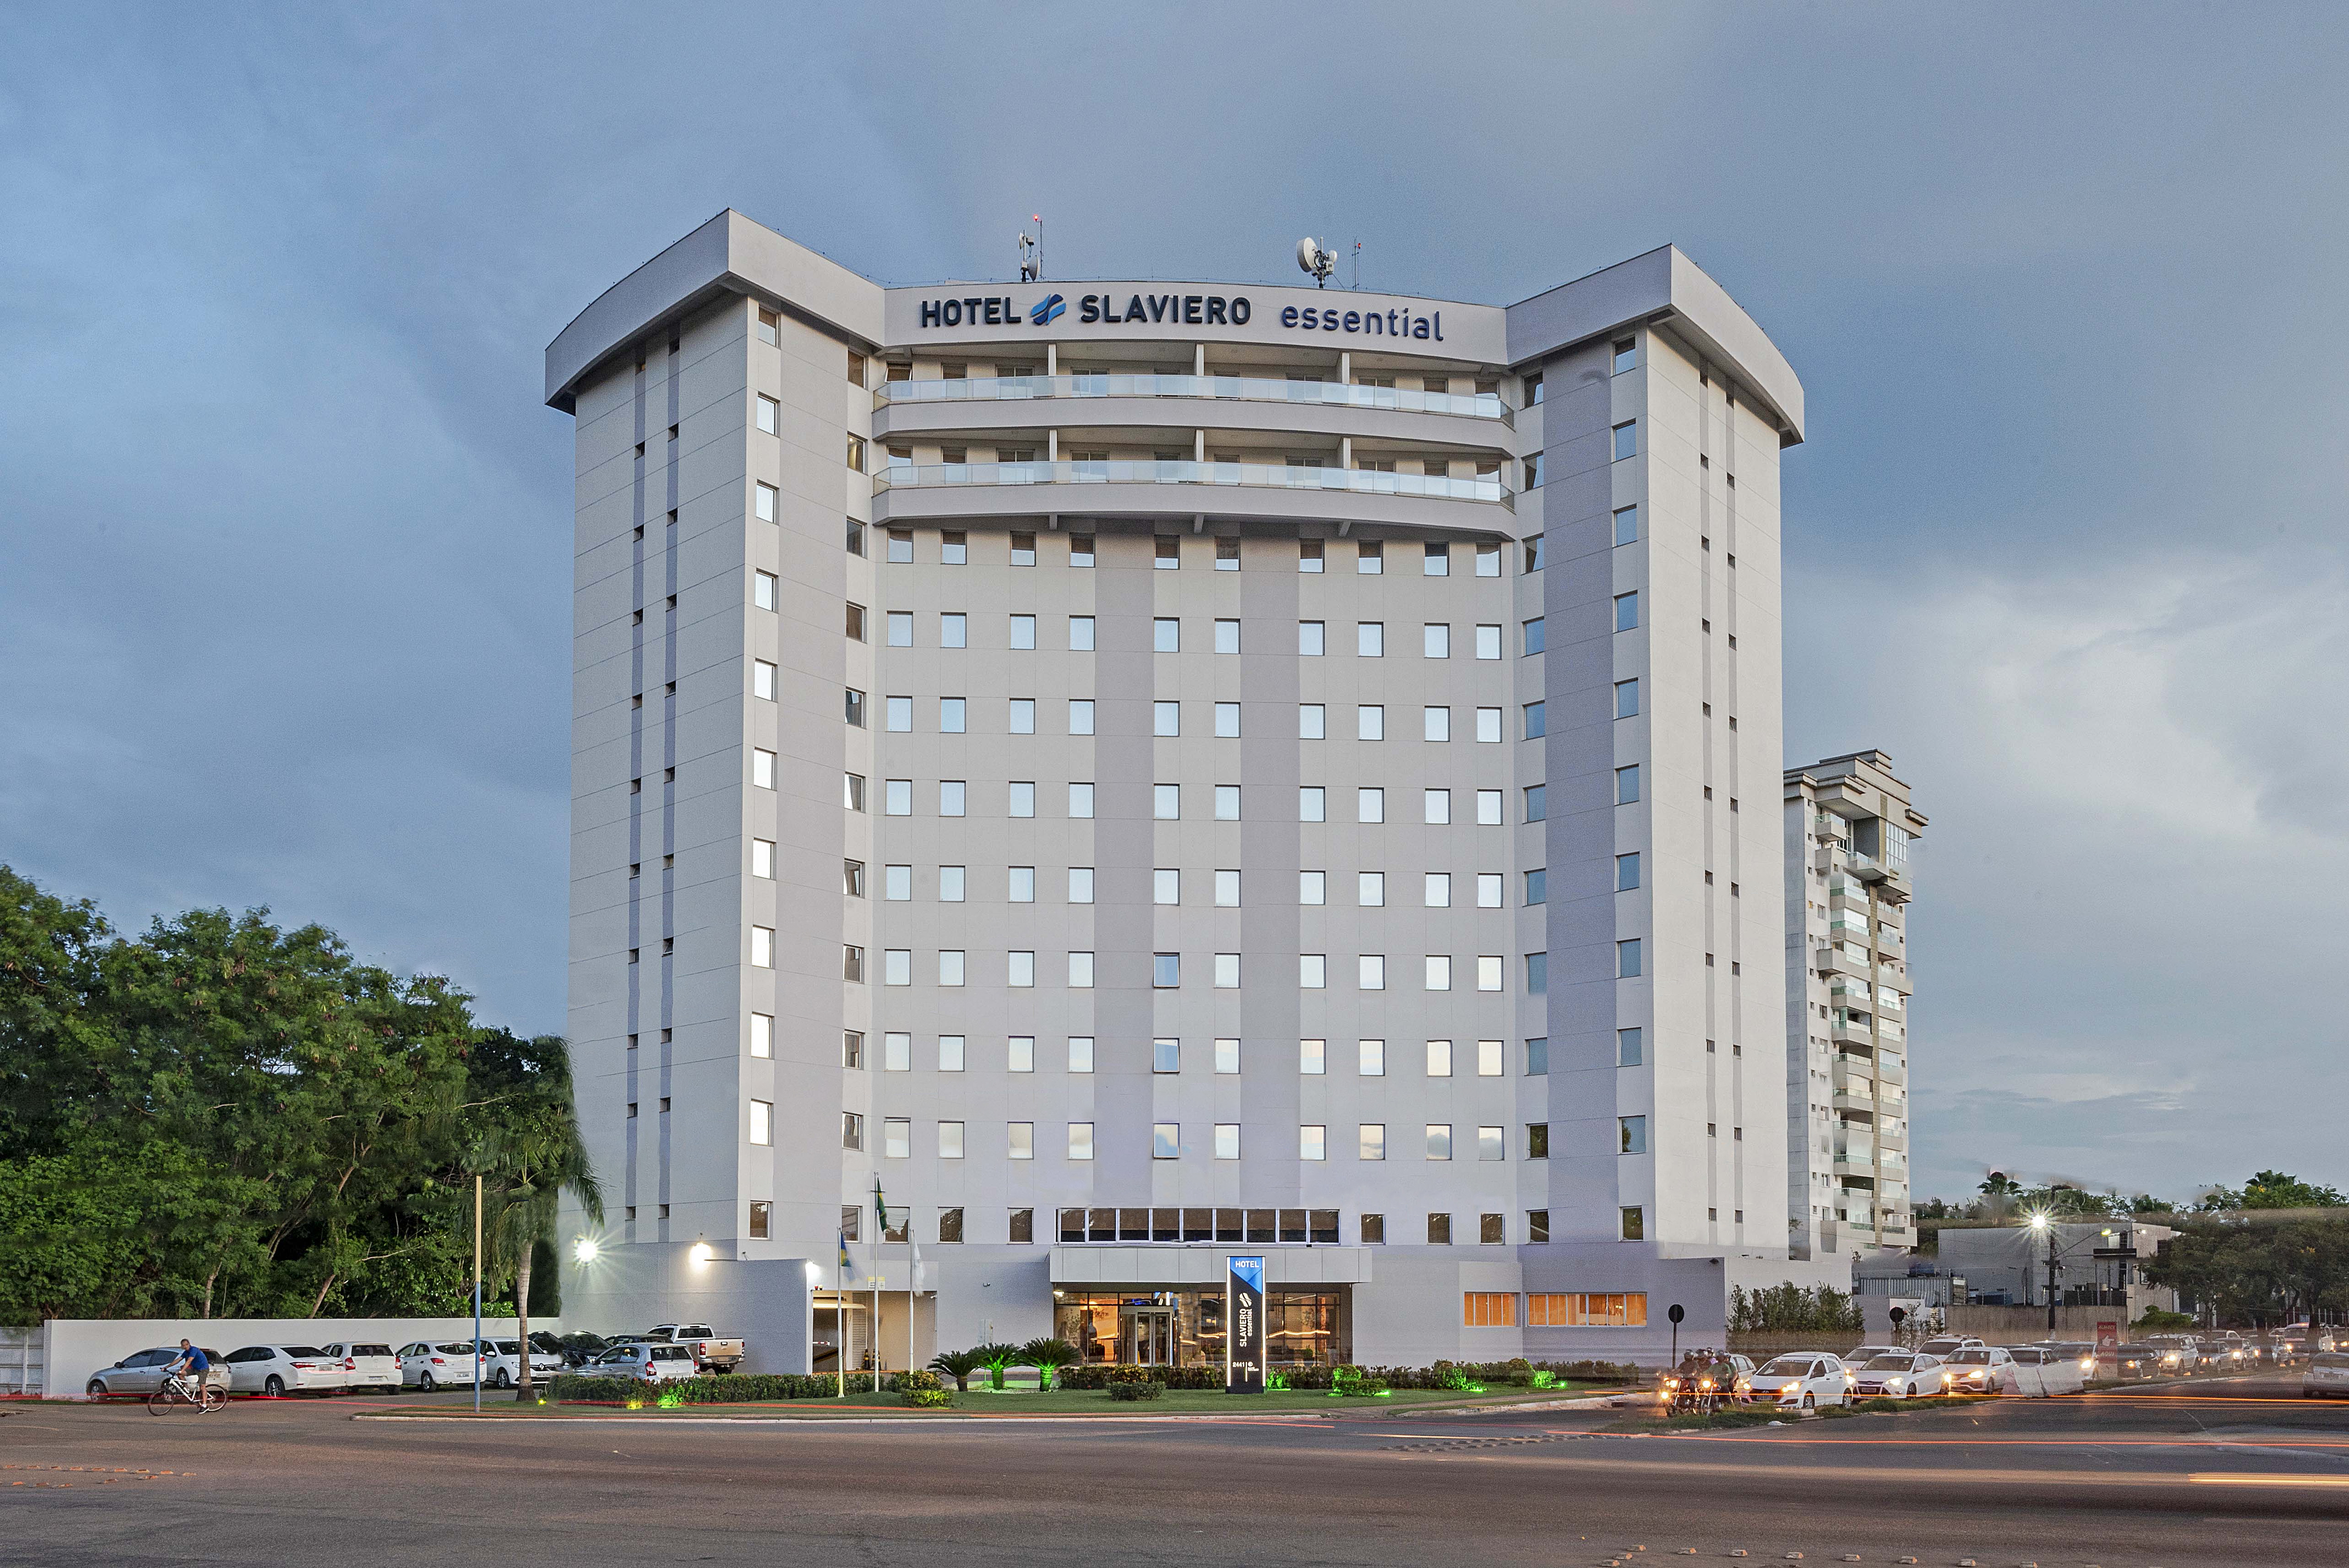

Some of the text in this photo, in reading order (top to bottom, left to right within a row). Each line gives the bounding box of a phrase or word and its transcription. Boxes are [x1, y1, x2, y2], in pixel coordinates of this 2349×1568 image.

[922, 294, 1444, 341] HOTEL SLAVIERO essential
